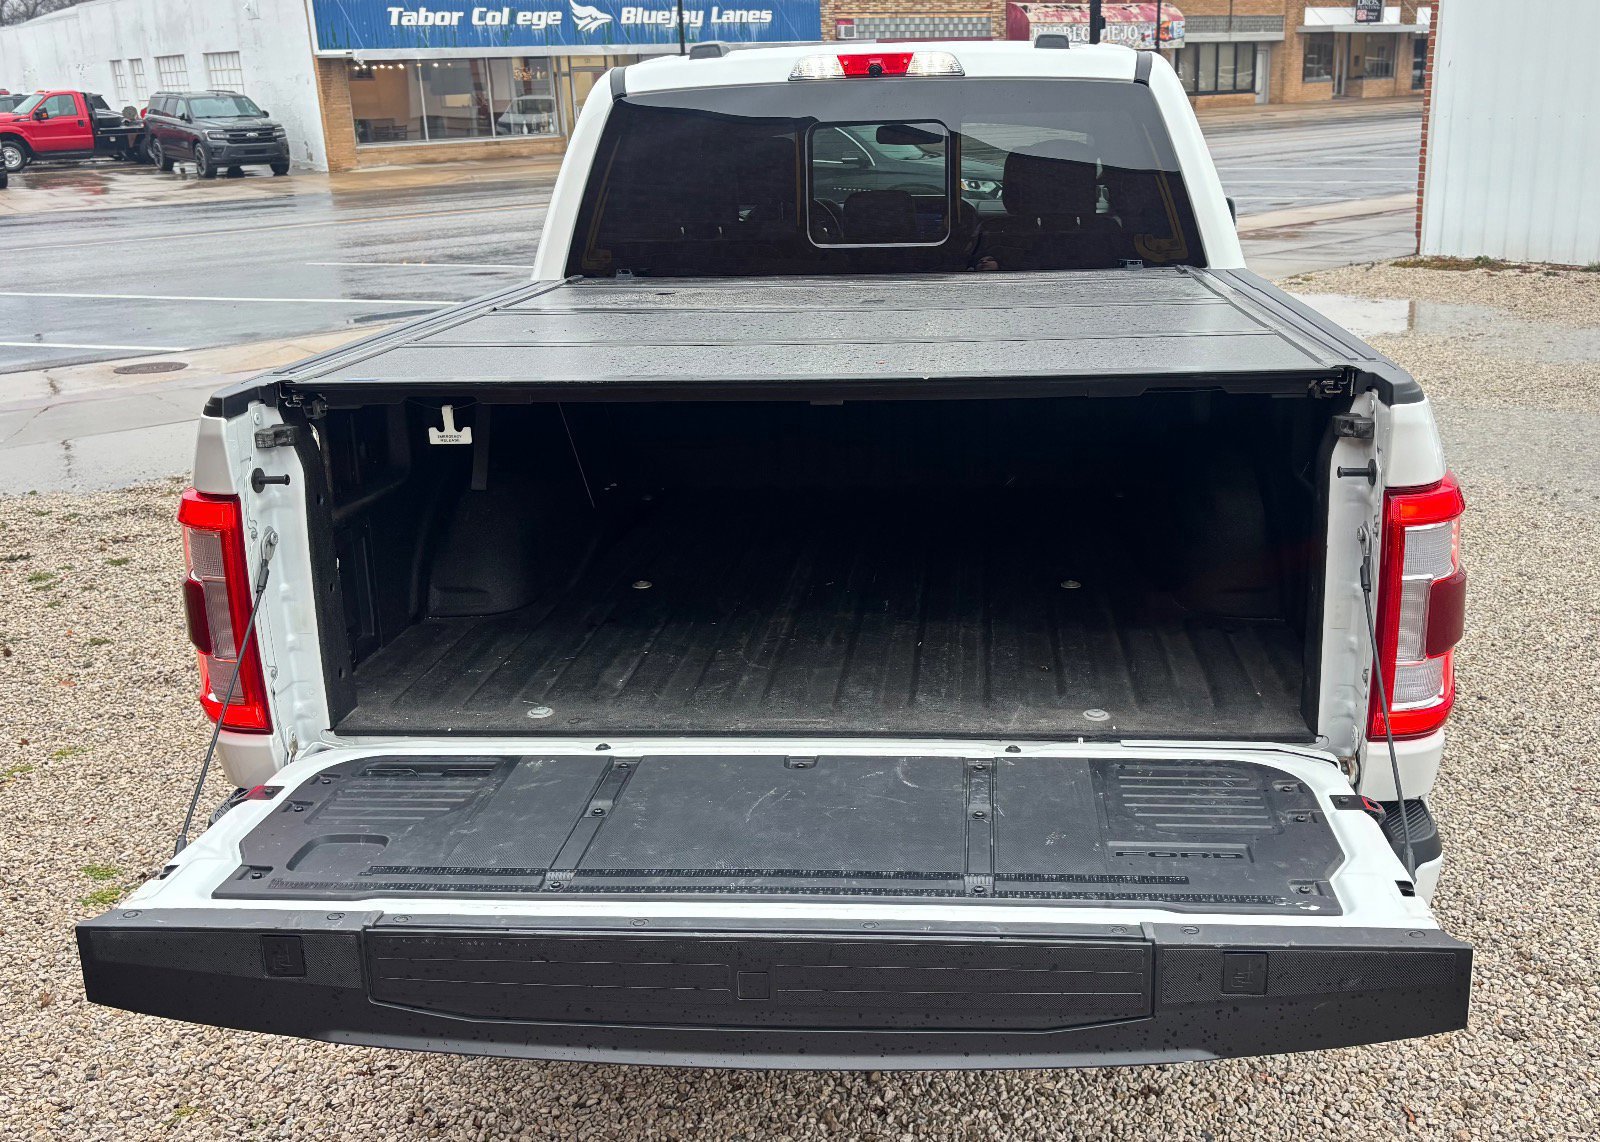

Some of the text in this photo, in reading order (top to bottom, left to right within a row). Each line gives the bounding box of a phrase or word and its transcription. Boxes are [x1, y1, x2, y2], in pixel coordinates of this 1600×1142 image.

[387, 6, 773, 30] Tabor Colege Bluejay Lanes
